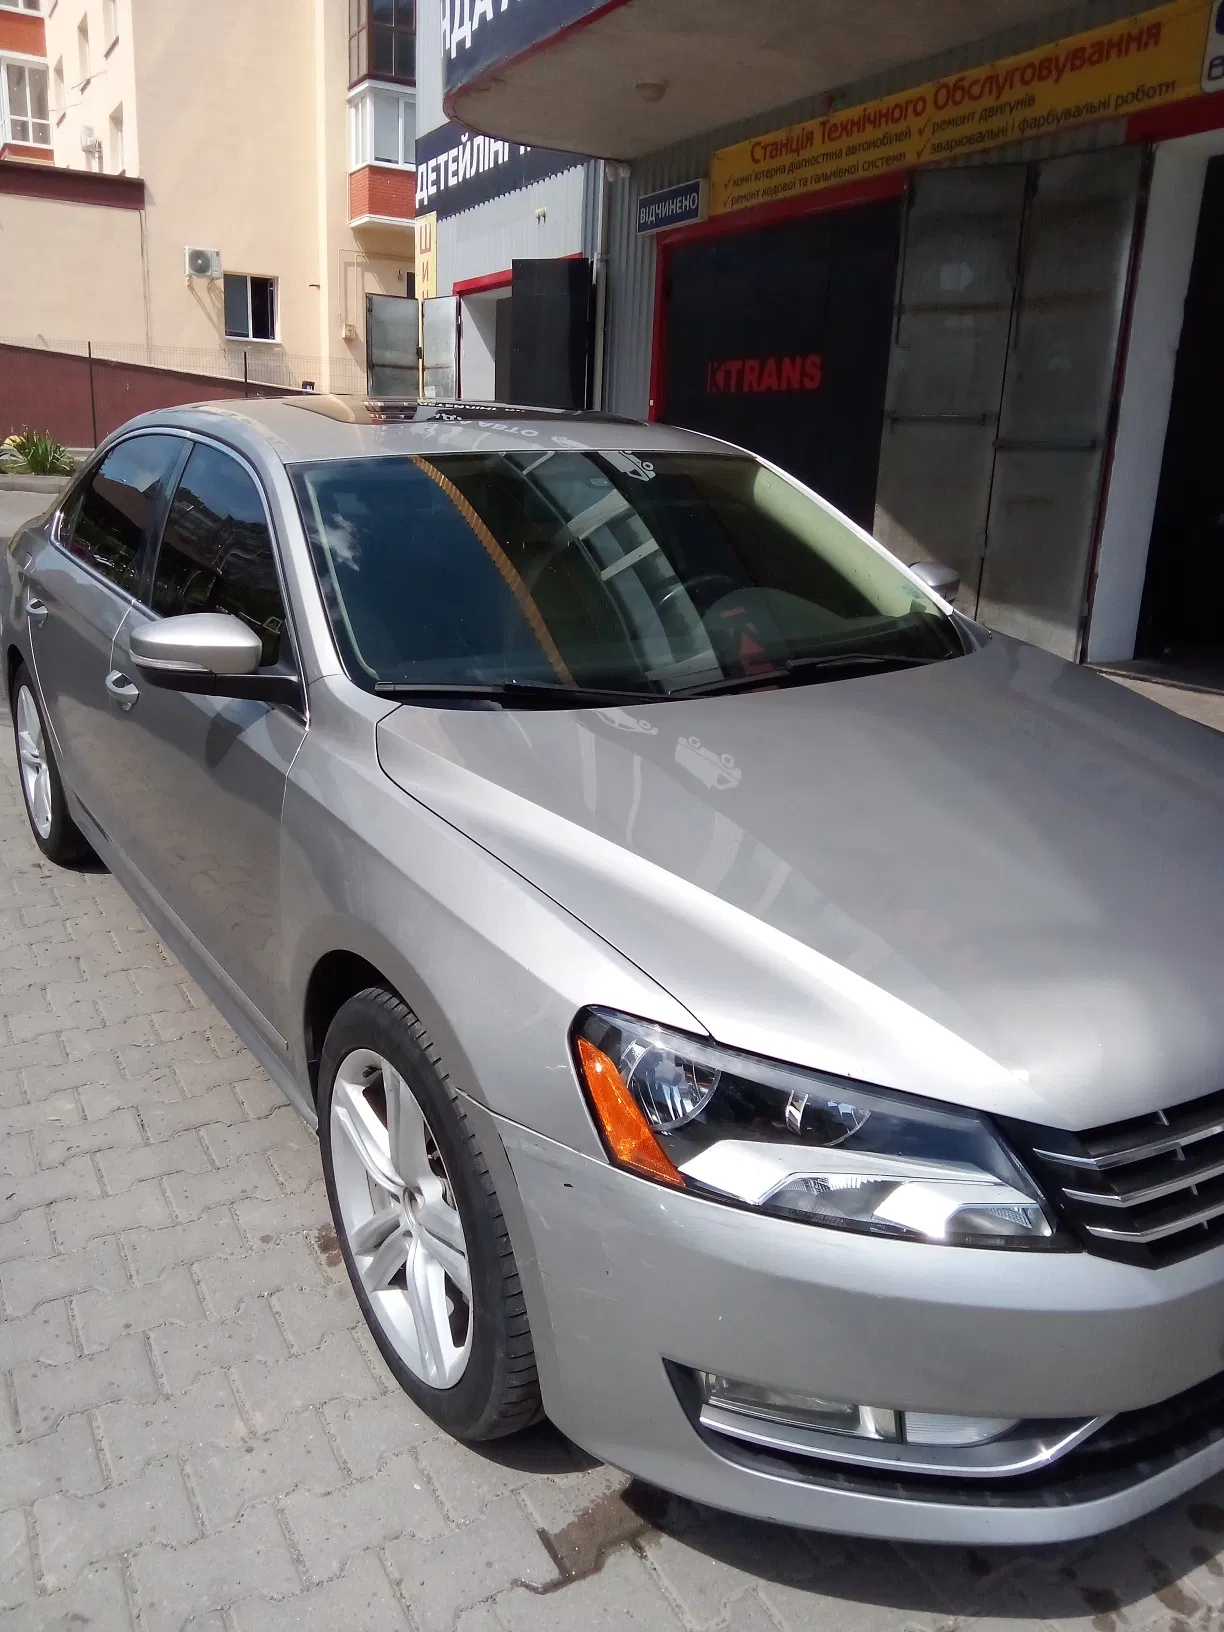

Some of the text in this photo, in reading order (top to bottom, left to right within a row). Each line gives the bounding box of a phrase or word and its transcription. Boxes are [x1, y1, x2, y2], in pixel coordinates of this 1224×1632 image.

[750, 21, 1162, 164] Станція Технічного Обслуговування
[1114, 79, 1176, 111] роботи
[932, 92, 1036, 136] ремонт двигунів
[862, 151, 906, 172] системи
[640, 192, 698, 224] ВІДЧИНЕНО
[419, 224, 432, 299] ШИ
